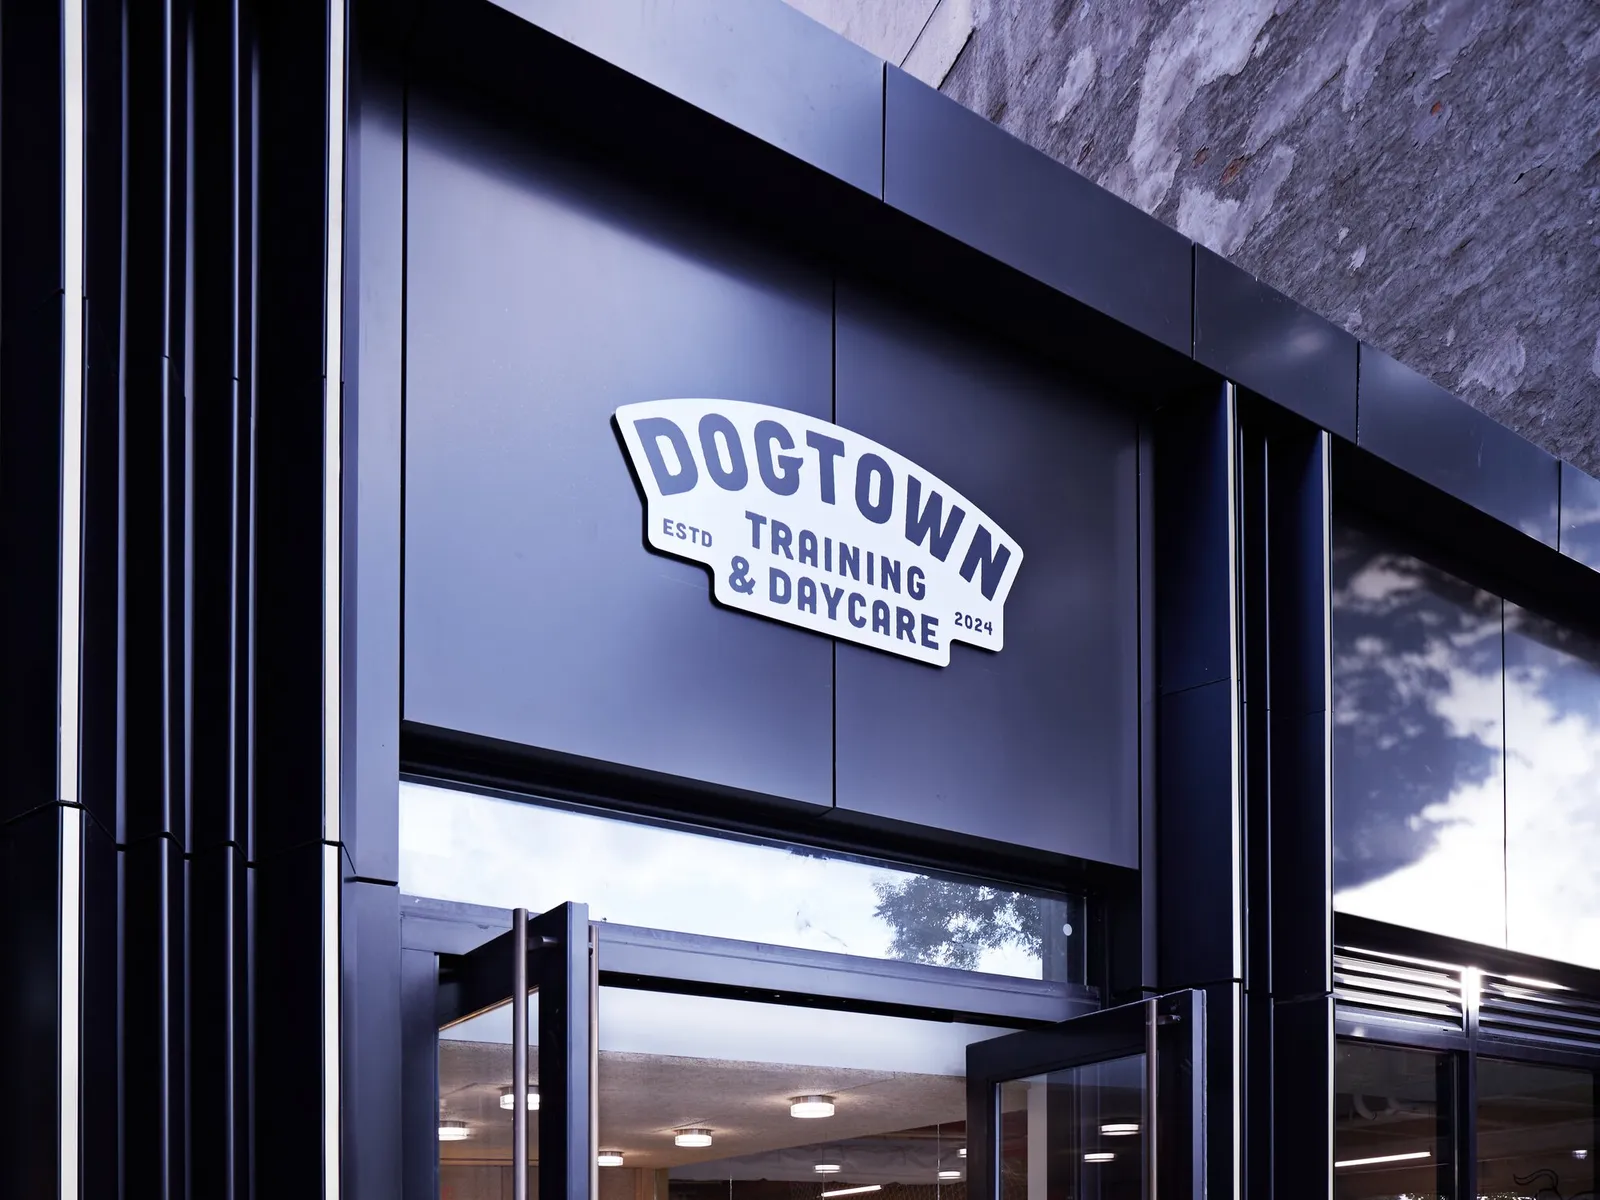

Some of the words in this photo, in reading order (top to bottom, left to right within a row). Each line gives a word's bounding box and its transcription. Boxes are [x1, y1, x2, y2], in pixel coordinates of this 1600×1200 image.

[633, 414, 1011, 601] DOGTOWN
[663, 518, 713, 547] ESTD
[745, 510, 926, 601] TRAINING
[729, 556, 755, 595] &
[769, 567, 939, 650] DAYCARE
[955, 612, 993, 635] 2024
